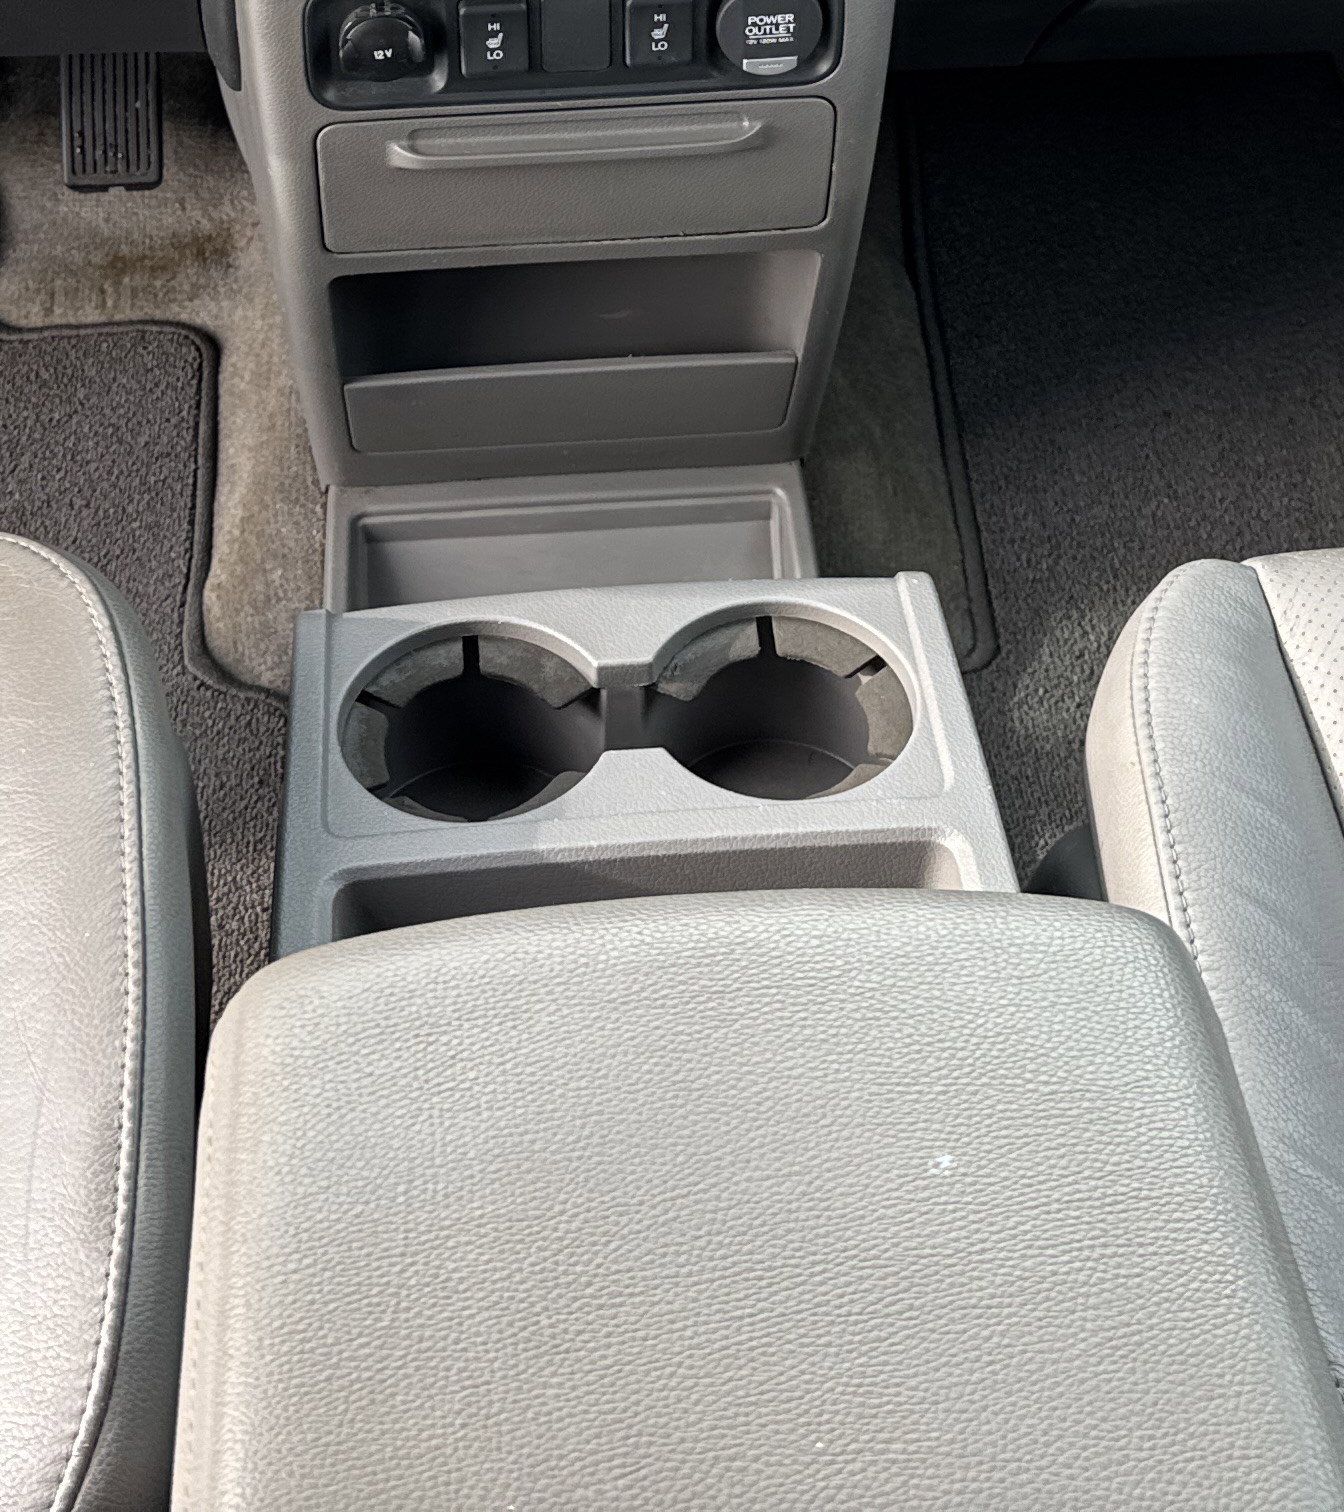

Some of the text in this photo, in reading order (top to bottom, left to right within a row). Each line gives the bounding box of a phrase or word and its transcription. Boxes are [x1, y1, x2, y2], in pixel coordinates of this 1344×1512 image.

[654, 13, 667, 22] HI
[747, 13, 795, 25] POWER
[487, 22, 501, 31] HI
[744, 23, 796, 36] OUTLET
[652, 41, 668, 51] LO
[486, 51, 504, 60] LO
